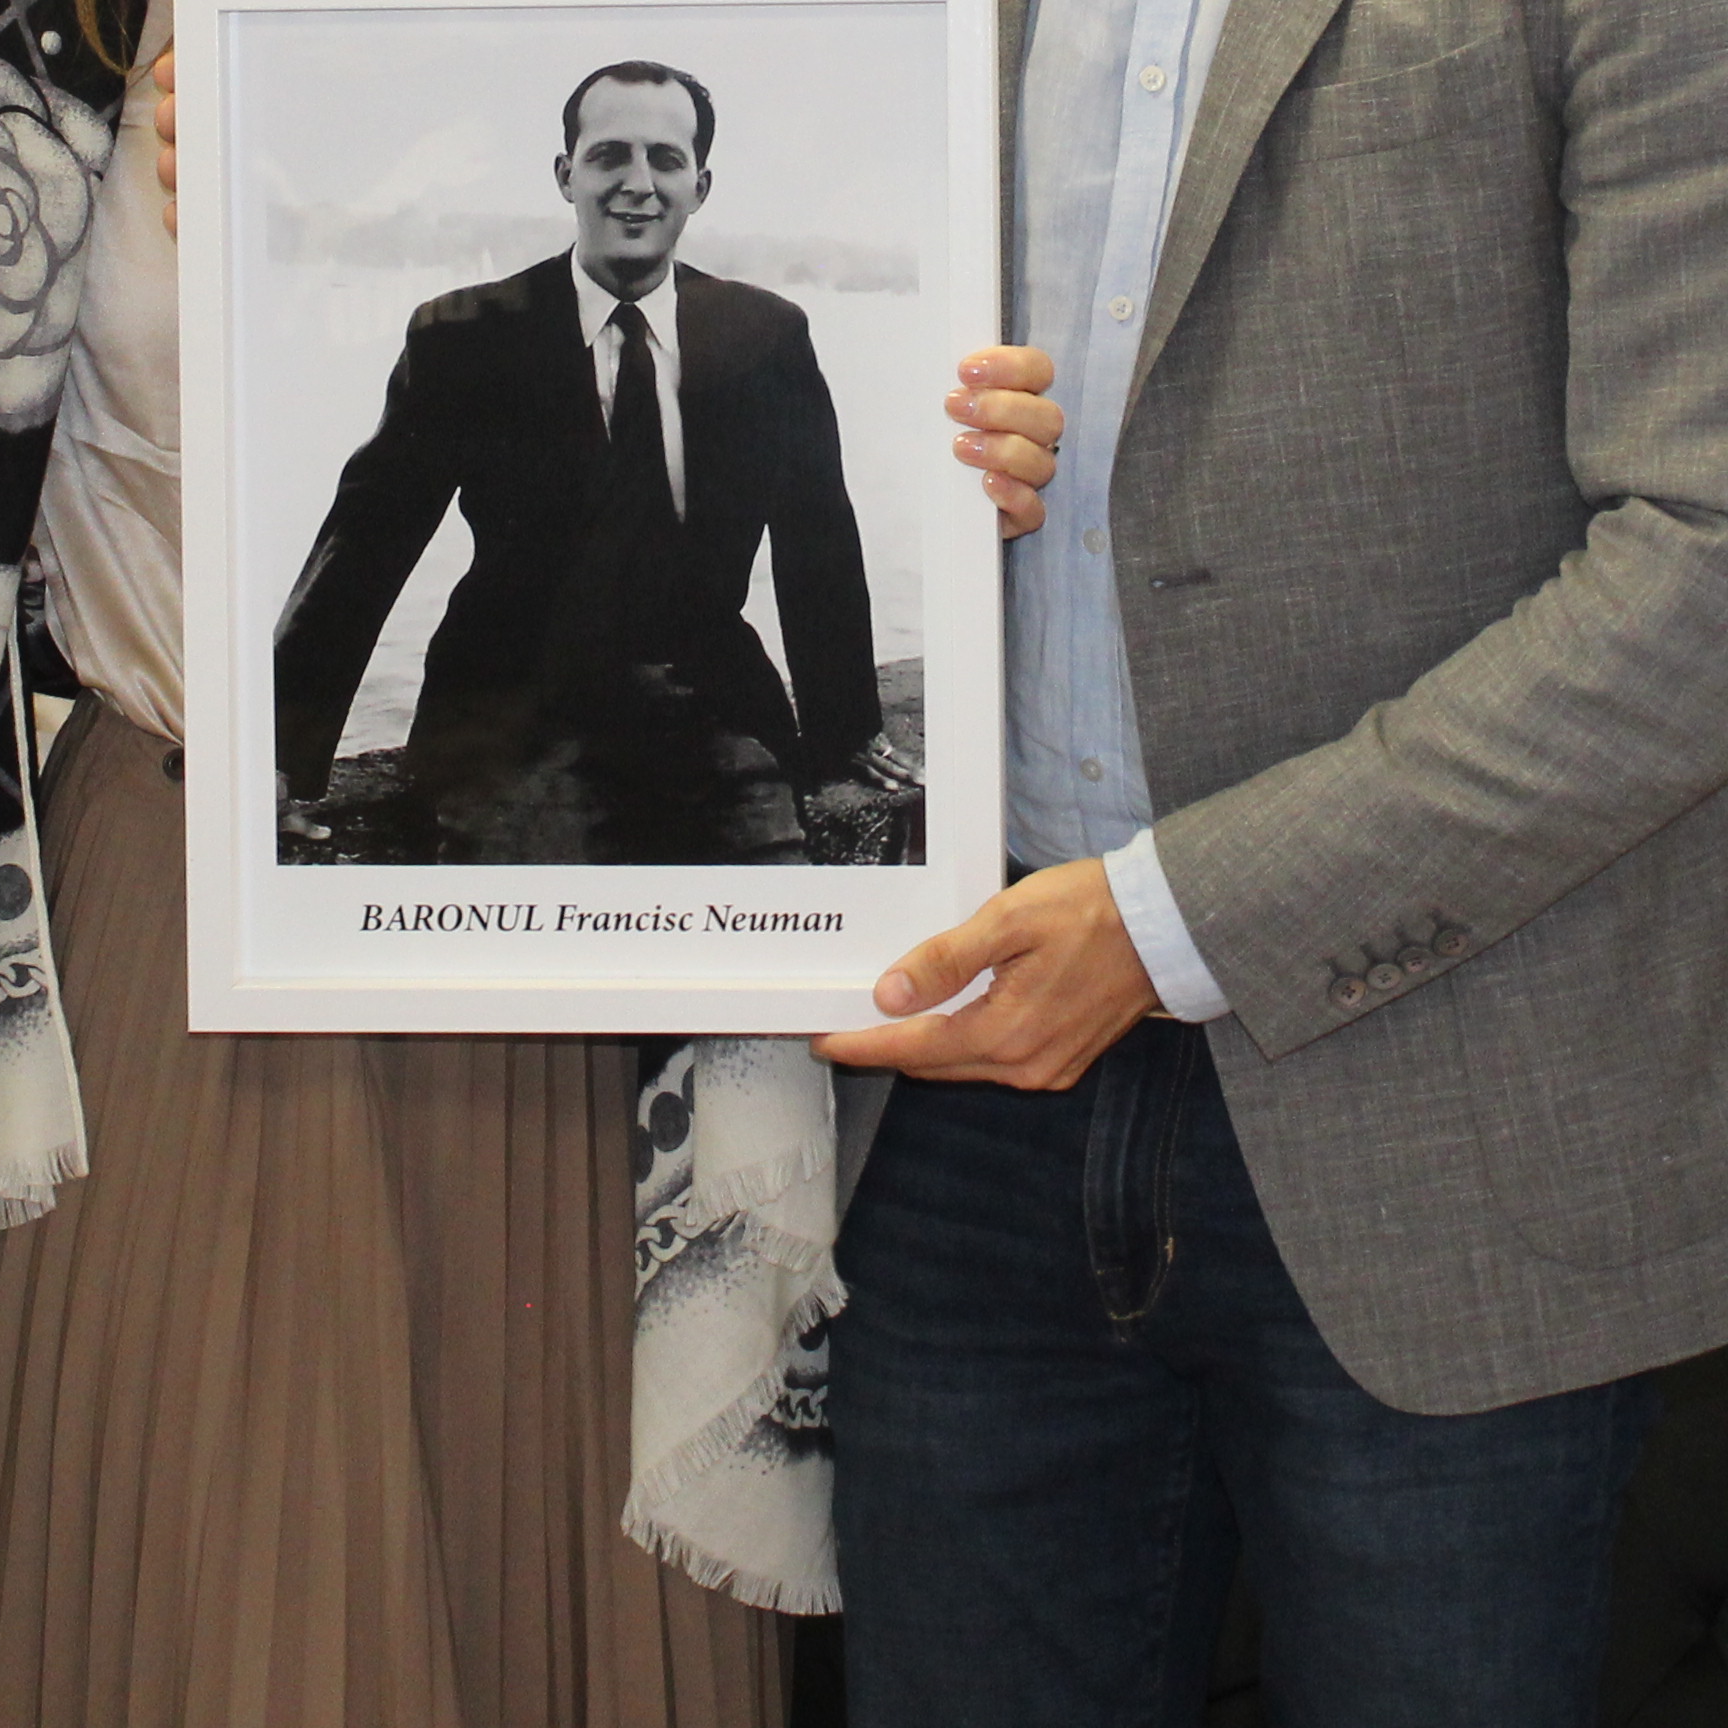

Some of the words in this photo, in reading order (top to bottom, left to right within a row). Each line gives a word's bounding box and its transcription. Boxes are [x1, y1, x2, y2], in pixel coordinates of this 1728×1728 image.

[359, 902, 545, 933] BARONUL
[553, 903, 695, 933] Francisc
[701, 903, 846, 933] Neuman
